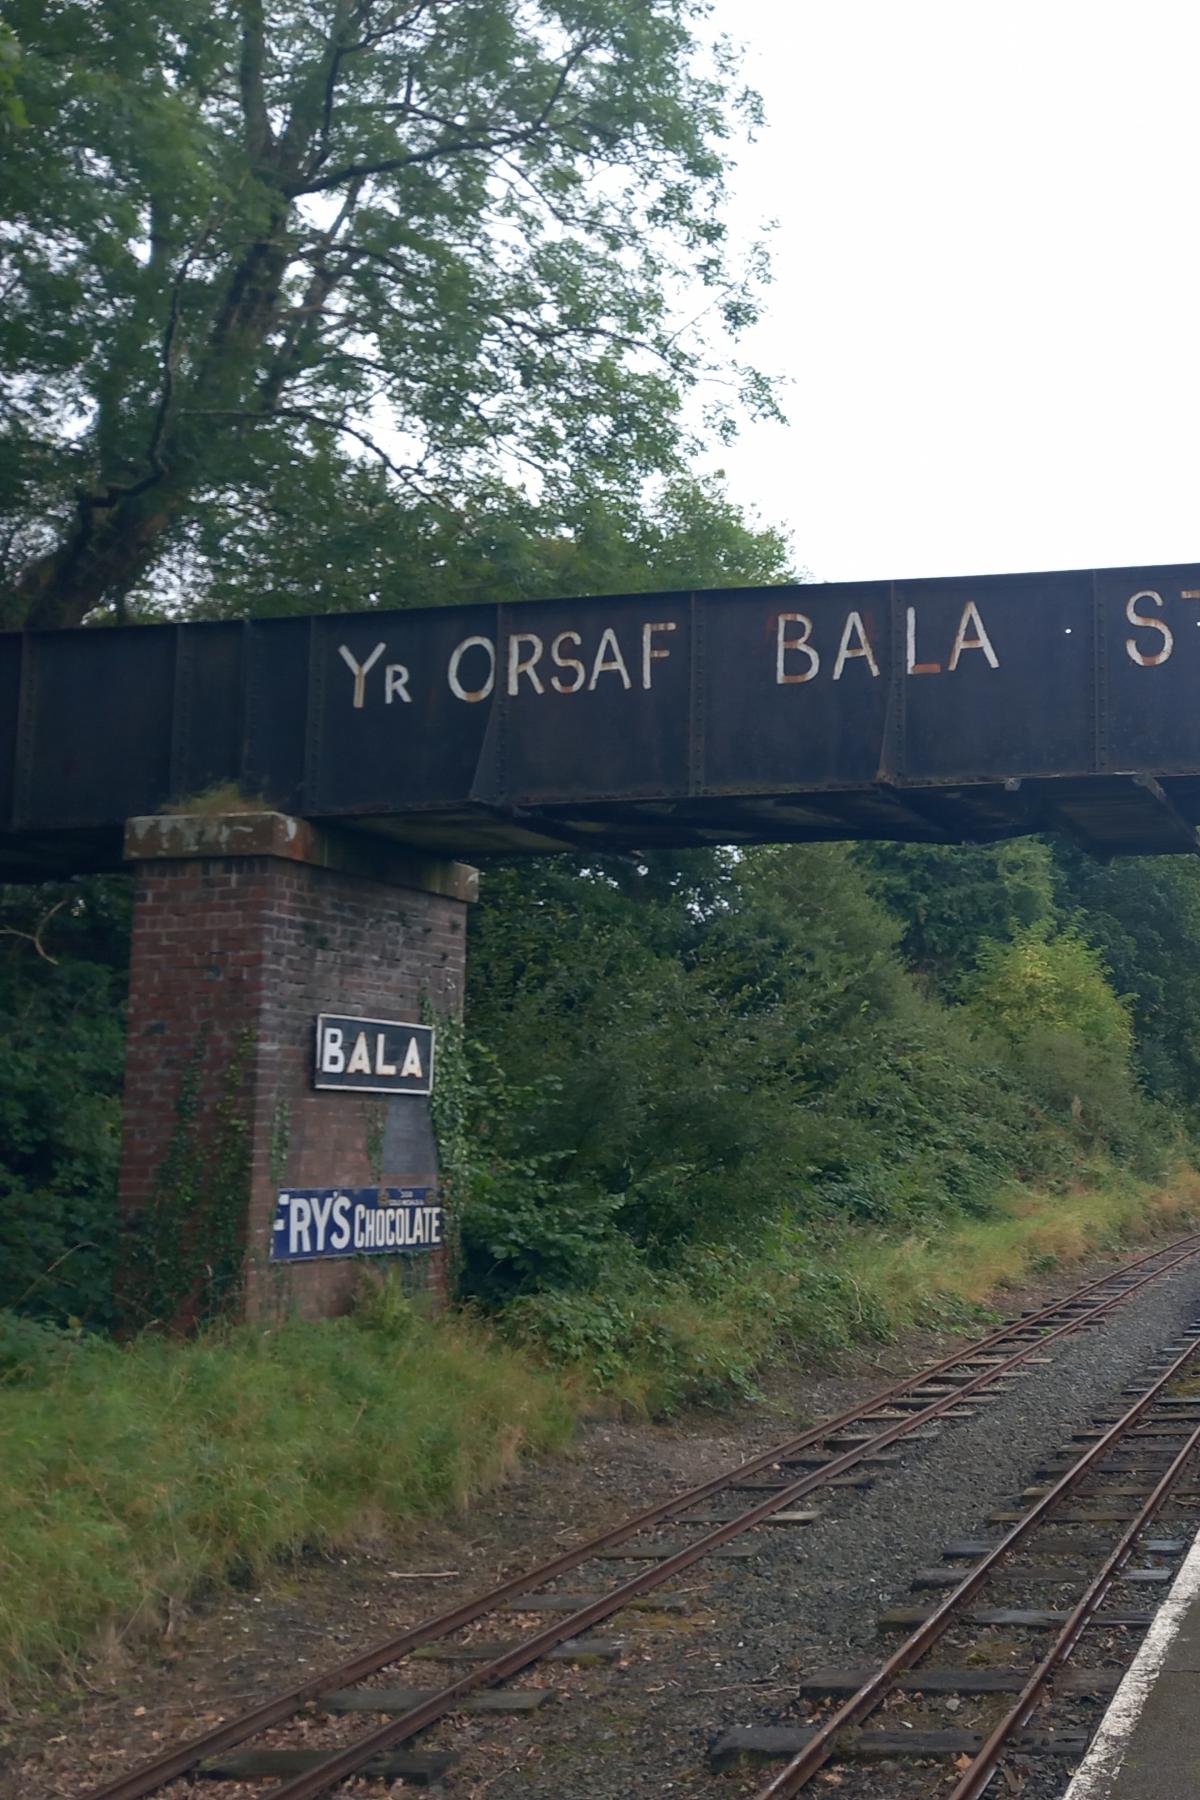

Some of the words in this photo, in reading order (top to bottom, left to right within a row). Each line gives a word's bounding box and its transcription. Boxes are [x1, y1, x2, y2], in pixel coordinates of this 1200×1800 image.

[448, 622, 677, 702] ORSAF
[776, 601, 1001, 684] BALA
[322, 1027, 423, 1078] BALA
[353, 1204, 442, 1249] CHOCOLATE
